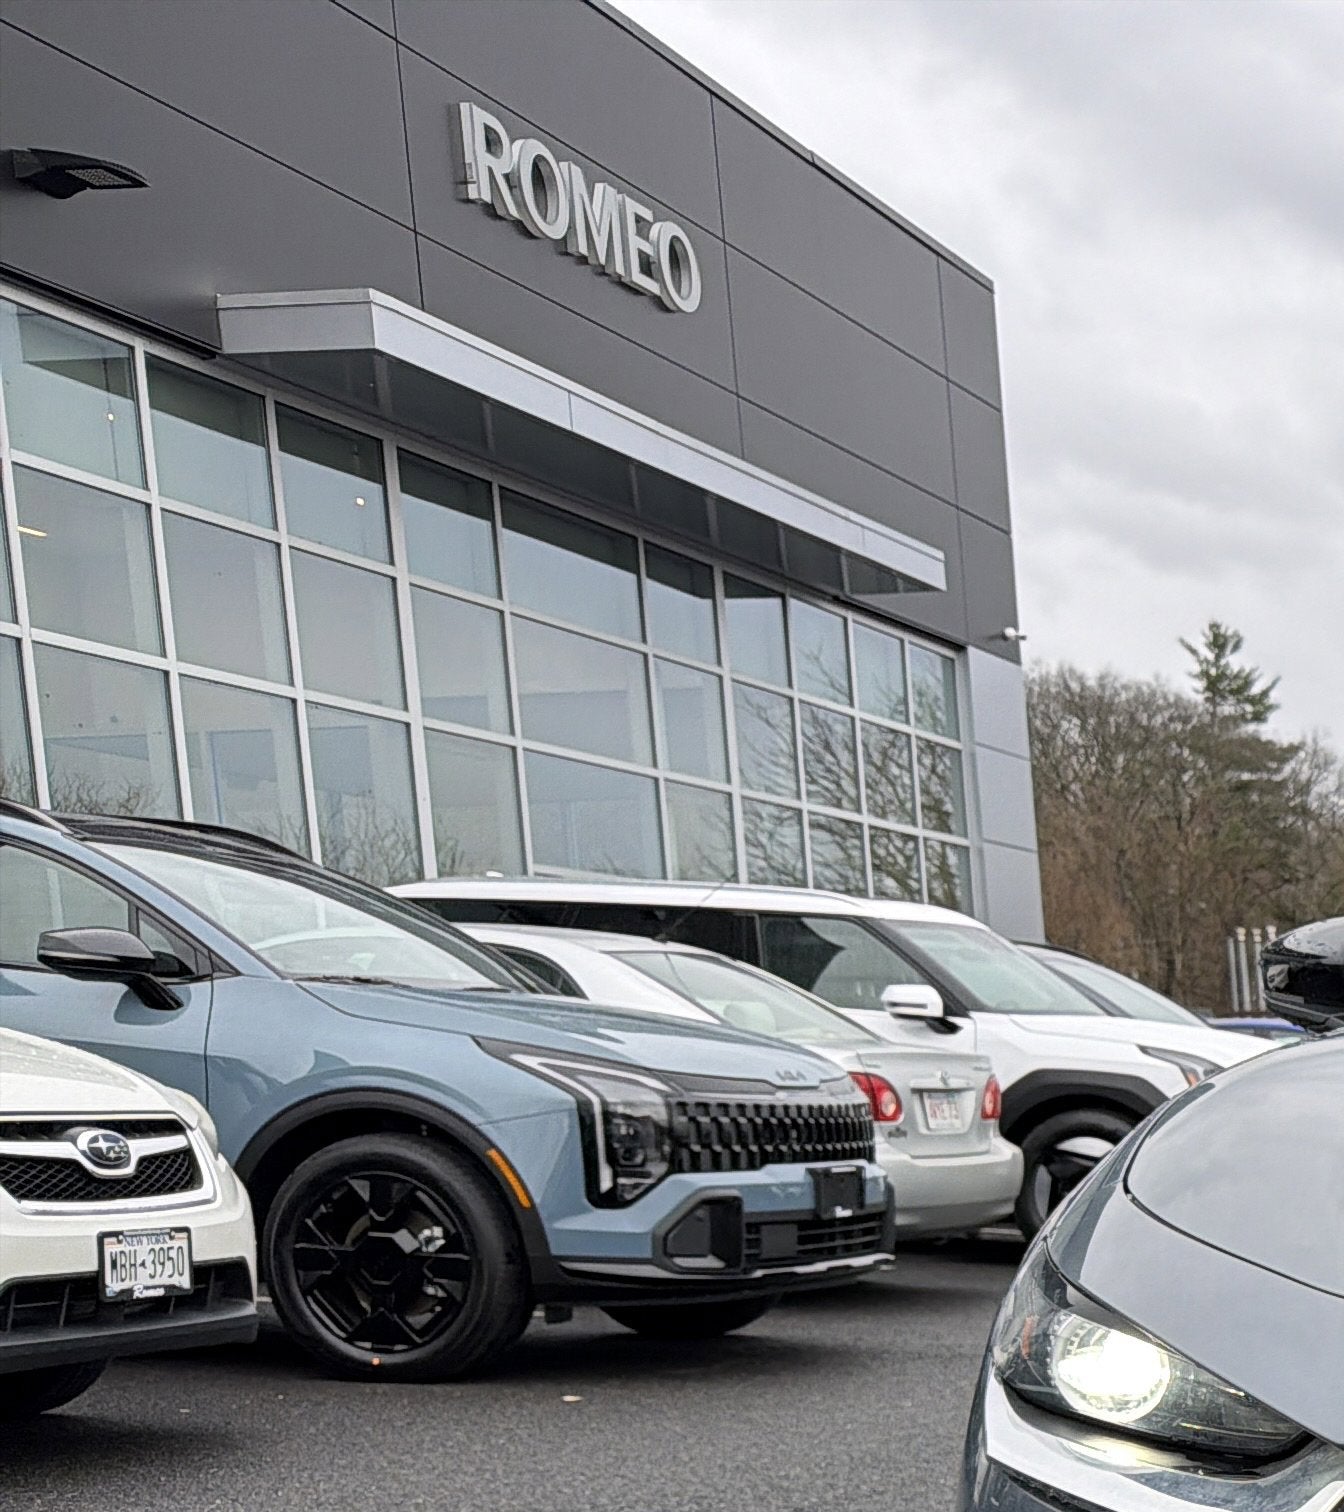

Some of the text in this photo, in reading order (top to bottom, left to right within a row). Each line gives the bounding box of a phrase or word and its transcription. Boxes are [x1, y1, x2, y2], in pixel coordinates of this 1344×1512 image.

[459, 102, 702, 313] ROMEO
[123, 1232, 168, 1247] NEW YORK
